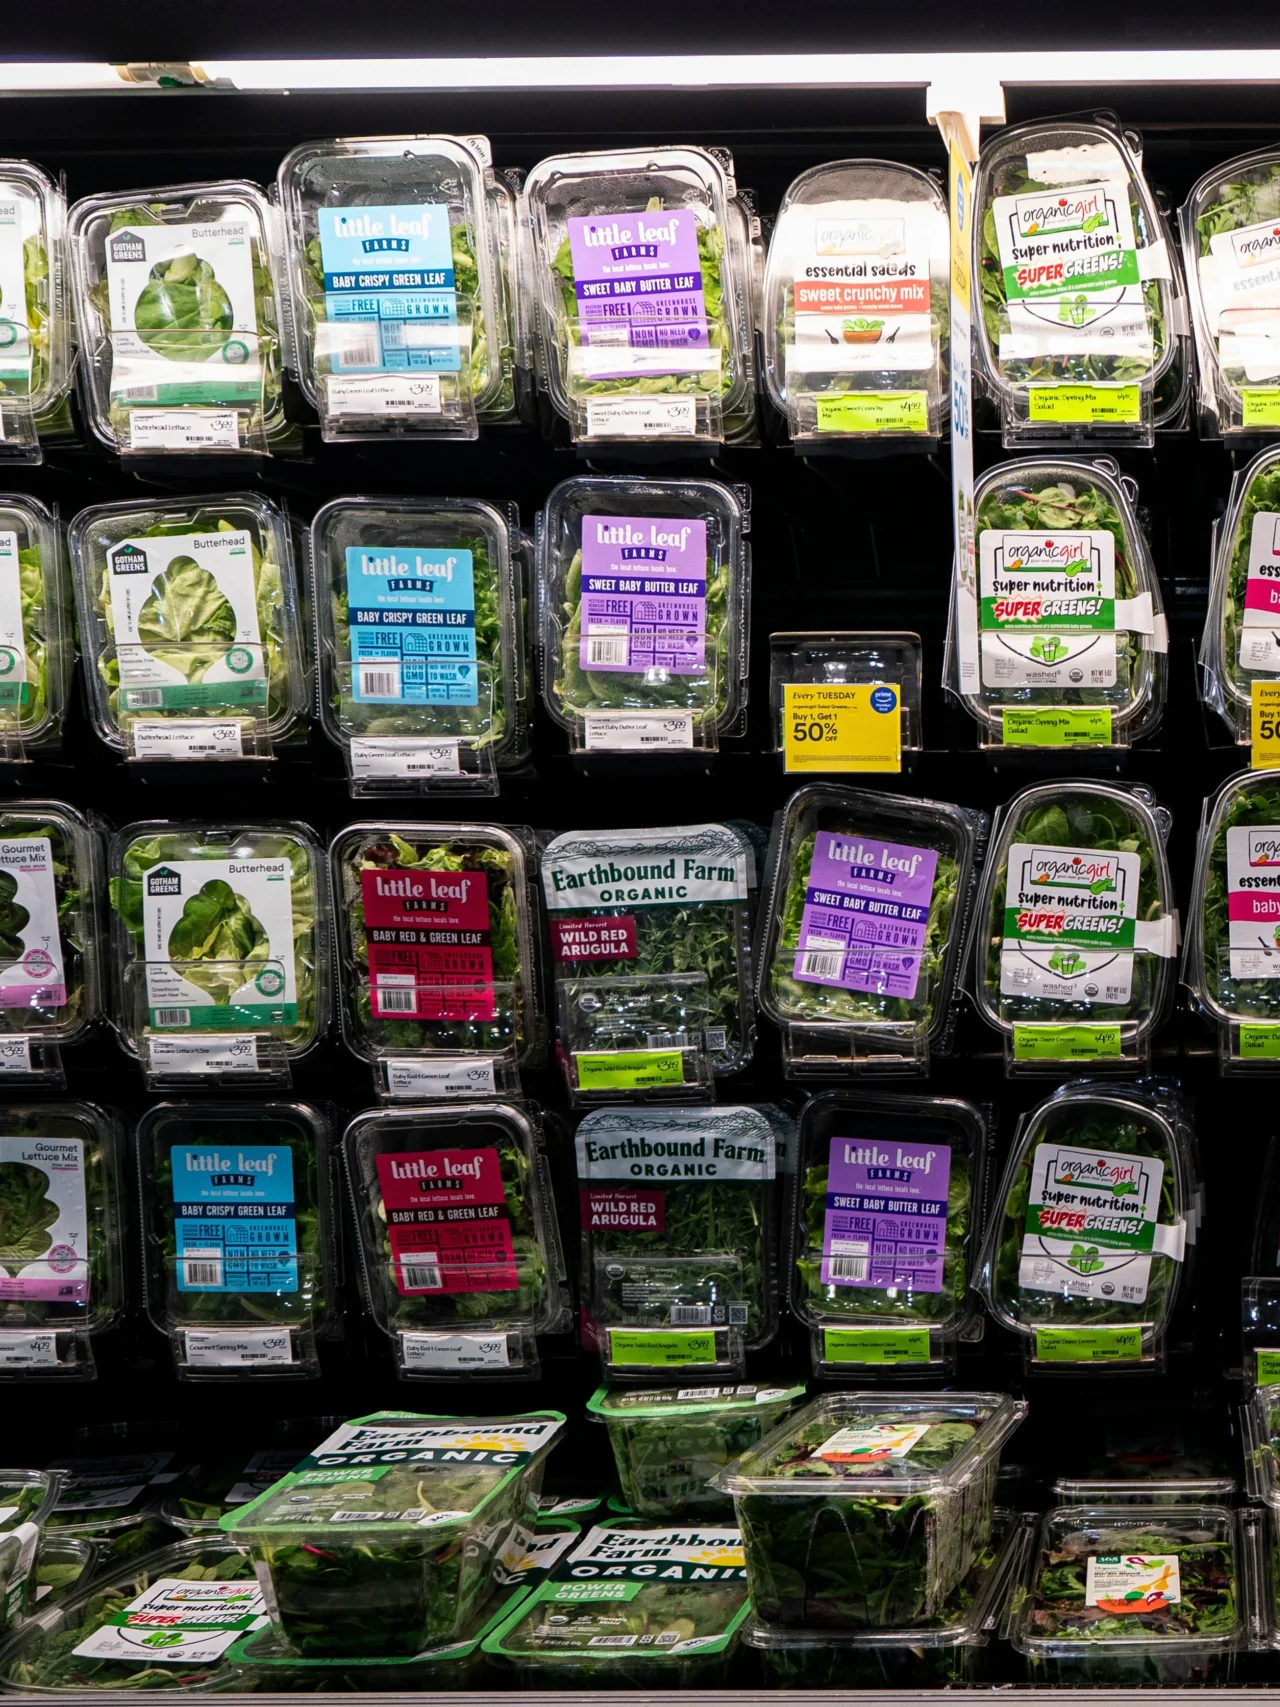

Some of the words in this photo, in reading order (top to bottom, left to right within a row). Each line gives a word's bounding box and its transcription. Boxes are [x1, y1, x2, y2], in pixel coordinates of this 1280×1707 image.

[1022, 196, 1101, 224] organicgirl
[192, 226, 244, 238] Butterhead
[333, 216, 384, 236] little
[390, 214, 432, 235] leaf
[583, 224, 633, 246] little
[638, 219, 679, 244] leaf
[113, 242, 142, 251] GOTHAM
[364, 239, 409, 253] FARMS
[1012, 243, 1050, 261] super
[1052, 235, 1114, 254] nutrition
[113, 250, 144, 260] GREENS
[805, 261, 867, 277] essential
[871, 264, 916, 277] salads
[333, 275, 356, 287] BABY
[359, 274, 389, 288] CRISPY
[393, 273, 420, 286] GREEN
[423, 273, 446, 285] LEAF
[583, 284, 610, 296] SWEET
[614, 282, 636, 294] BABY
[640, 280, 670, 293] BUTTER
[673, 277, 694, 290] LEAF
[800, 286, 841, 304] sweet
[844, 287, 897, 304] crunchy
[900, 286, 924, 300] mix
[194, 537, 245, 549] Butterhead
[597, 525, 644, 546] little
[651, 527, 692, 551] leaf
[624, 549, 664, 559] FARMS
[1008, 540, 1084, 566] organicgirl
[361, 555, 409, 576] little
[416, 556, 457, 582] leaf
[620, 564, 632, 572] local
[633, 564, 650, 572] lettuce
[651, 564, 665, 572] locals
[667, 565, 678, 573] love.
[589, 579, 616, 591] SWEET
[619, 580, 642, 592] BABY
[645, 581, 675, 592] BUTTER
[678, 582, 698, 593] LEAF
[992, 579, 1030, 594] super
[1033, 579, 1094, 592] nutrition
[606, 600, 628, 613] FREE
[658, 610, 698, 621] GROWN
[793, 692, 815, 700] Every
[793, 713, 807, 721] Buy
[793, 723, 837, 741] 50%
[2, 845, 44, 855] Gourmet
[229, 864, 284, 874] Butterhead
[551, 857, 676, 892] Earthbound
[682, 858, 736, 882] Farm
[1036, 857, 1110, 884] organicgirl
[150, 878, 178, 886] GOTHAM
[150, 885, 178, 893] GREENS
[376, 877, 424, 898] little
[430, 879, 470, 904] leaf
[599, 886, 688, 902] ORGANIC
[1018, 892, 1054, 907] super
[1057, 895, 1117, 910] nutrition
[373, 929, 397, 942] BABY
[400, 931, 416, 942] RED
[419, 932, 426, 942] &
[429, 932, 456, 944] GREEN
[460, 933, 482, 945] LEAF
[560, 930, 595, 943] WILD
[600, 930, 628, 941] RED
[561, 941, 629, 956] ARUGULA
[35, 1142, 78, 1153] Gourmet
[586, 1137, 706, 1163] Earthbound
[713, 1139, 765, 1163] Farm
[21, 1152, 61, 1162] Lettuce
[63, 1153, 79, 1162] Mix
[185, 1153, 232, 1172] little
[238, 1154, 278, 1177] leaf
[630, 1163, 718, 1176] ORGANIC
[1060, 1160, 1134, 1186] organicgirl
[350, 1424, 549, 1441] Earthbound
[337, 1438, 424, 1450] Farm
[318, 1451, 520, 1465] ORGANIC
[588, 1546, 671, 1559] Farm
[555, 1591, 624, 1599] GREENS
[560, 1584, 626, 1592] POWER
[142, 1603, 179, 1614] super
[182, 1603, 248, 1612] nutrition
